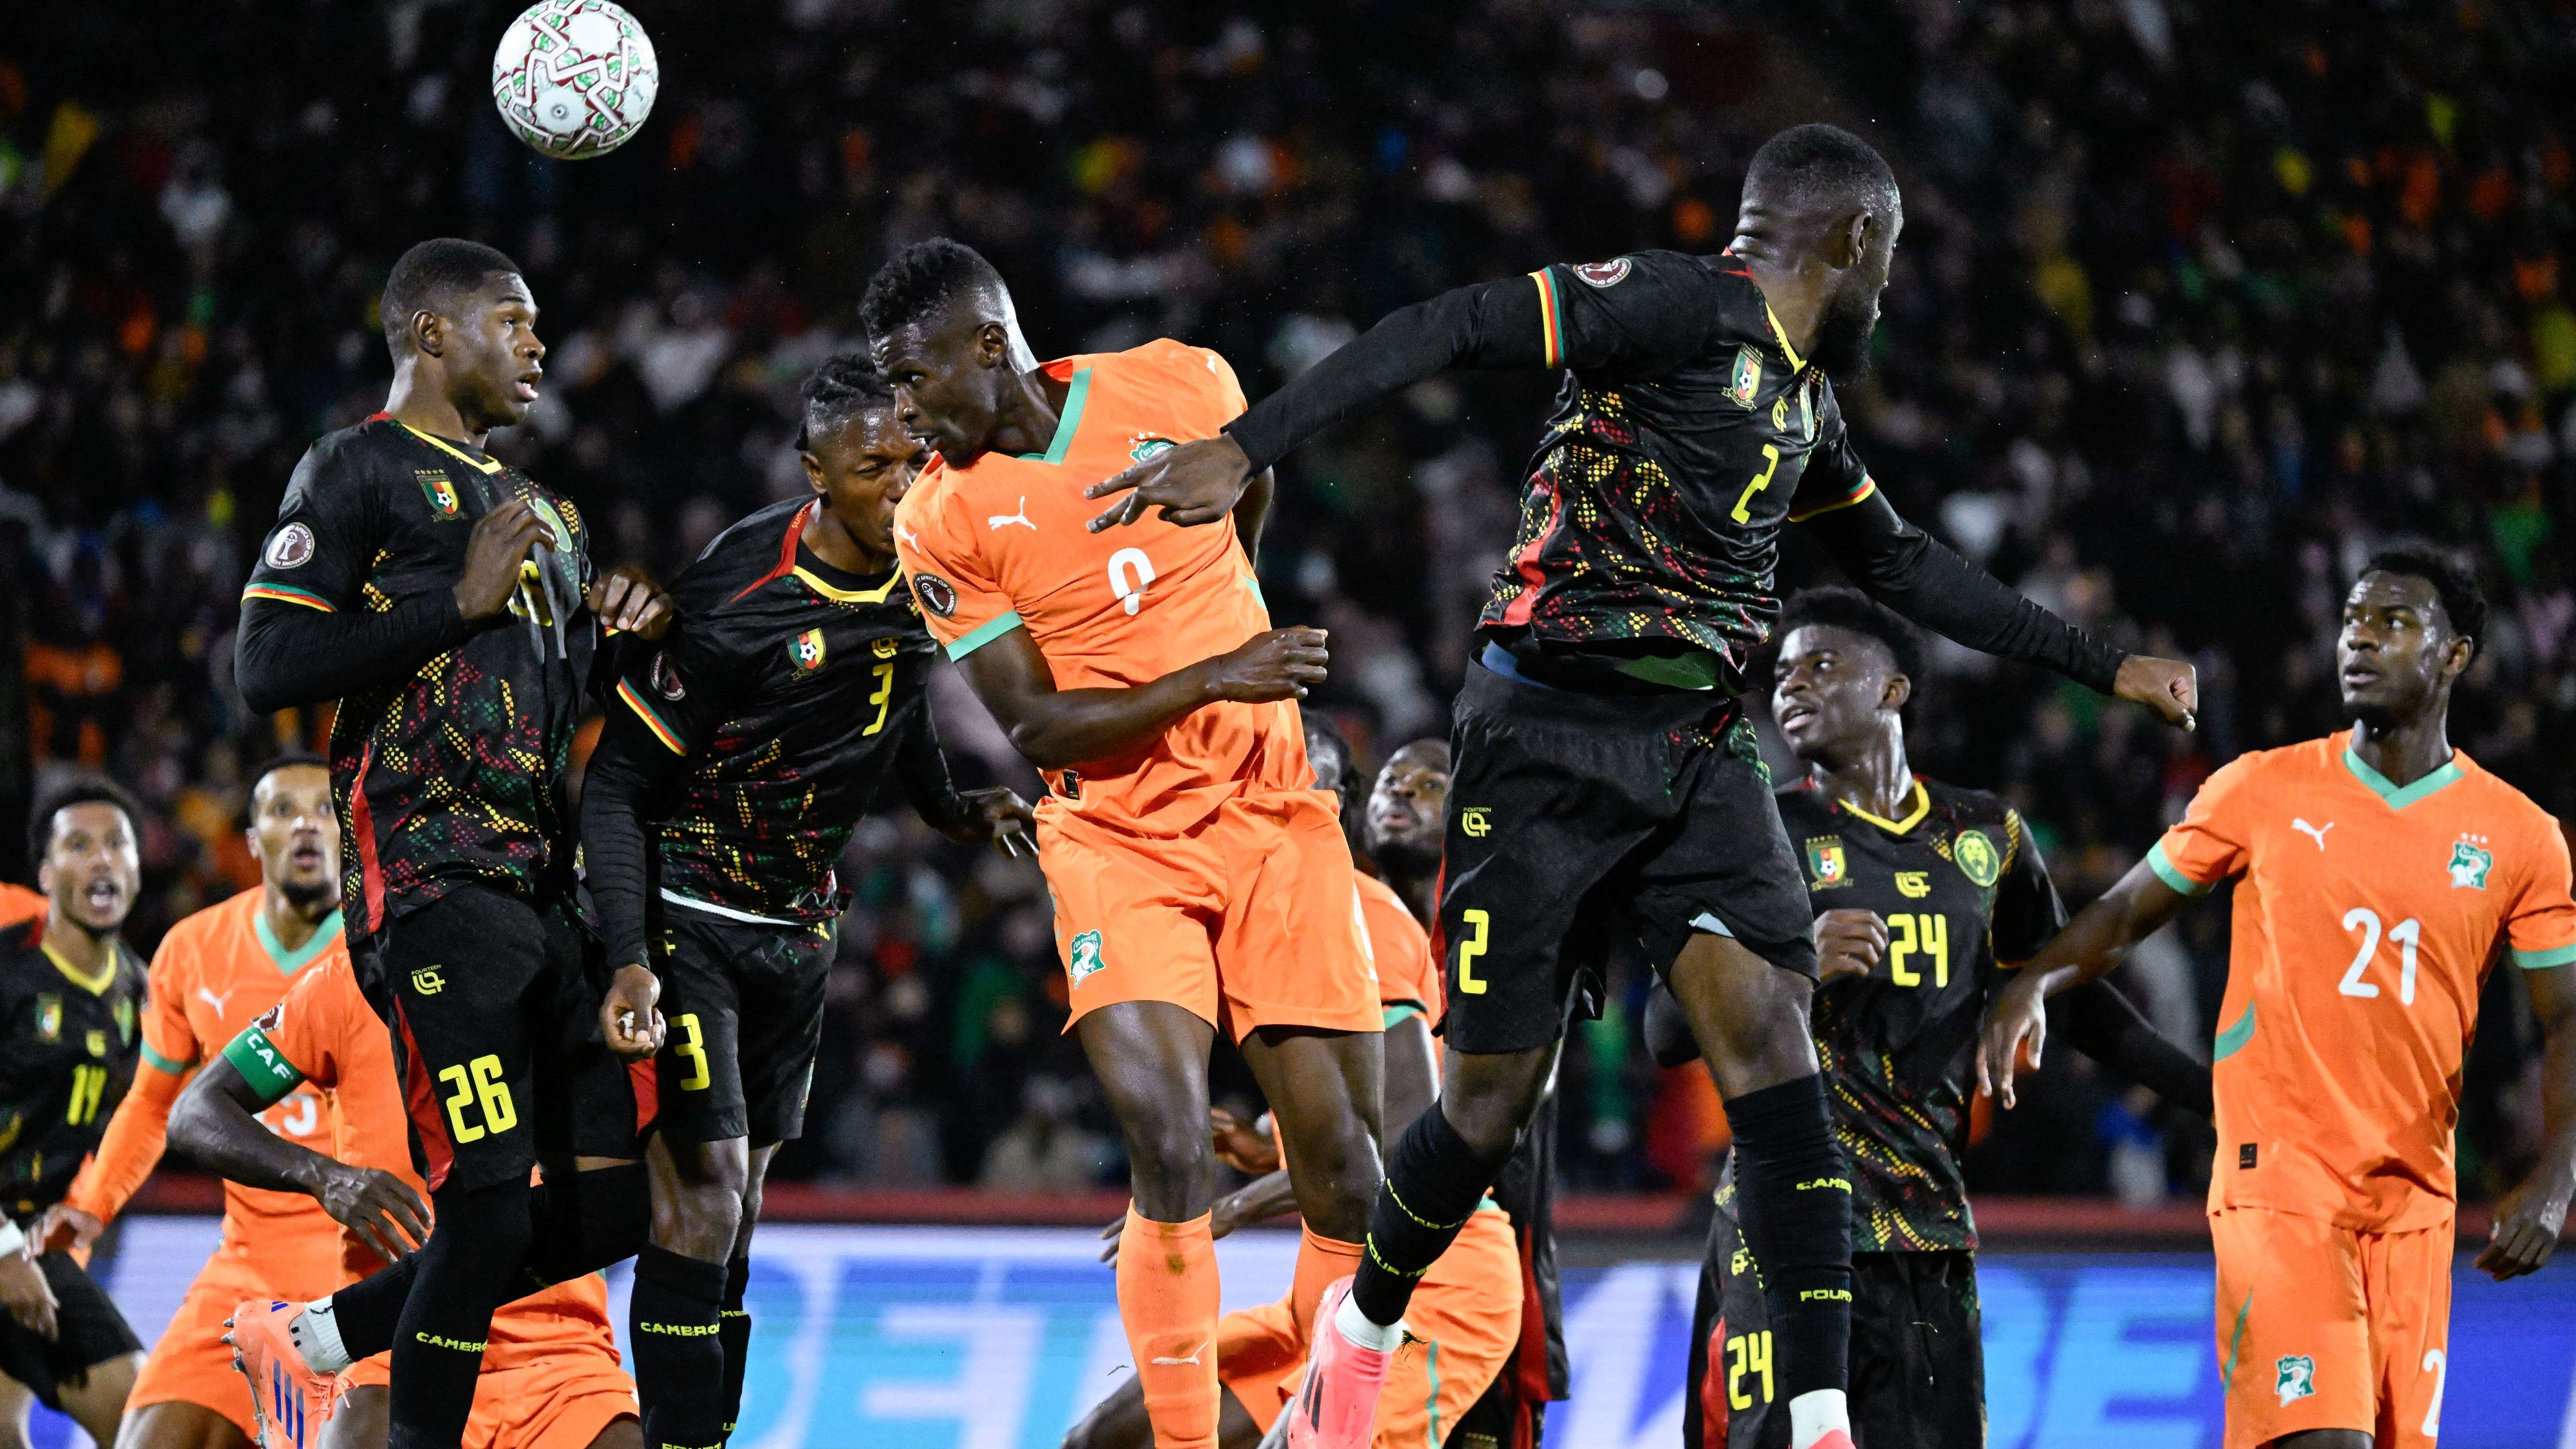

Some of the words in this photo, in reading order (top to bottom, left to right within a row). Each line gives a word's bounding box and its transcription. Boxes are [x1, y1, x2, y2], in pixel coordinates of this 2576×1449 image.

[1731, 444, 1779, 525] 2
[938, 580, 948, 588] CUP
[1108, 547, 1156, 616] 9
[411, 964, 441, 976] FOURTEEN
[1459, 909, 1489, 994] 2
[1887, 914, 1948, 987] 24
[2339, 907, 2420, 1005] 21
[247, 1034, 292, 1079] CAF
[669, 1014, 710, 1091] 3
[439, 1054, 517, 1144] 26
[640, 1322, 720, 1336] CAMERO
[1727, 1330, 1774, 1411] 24
